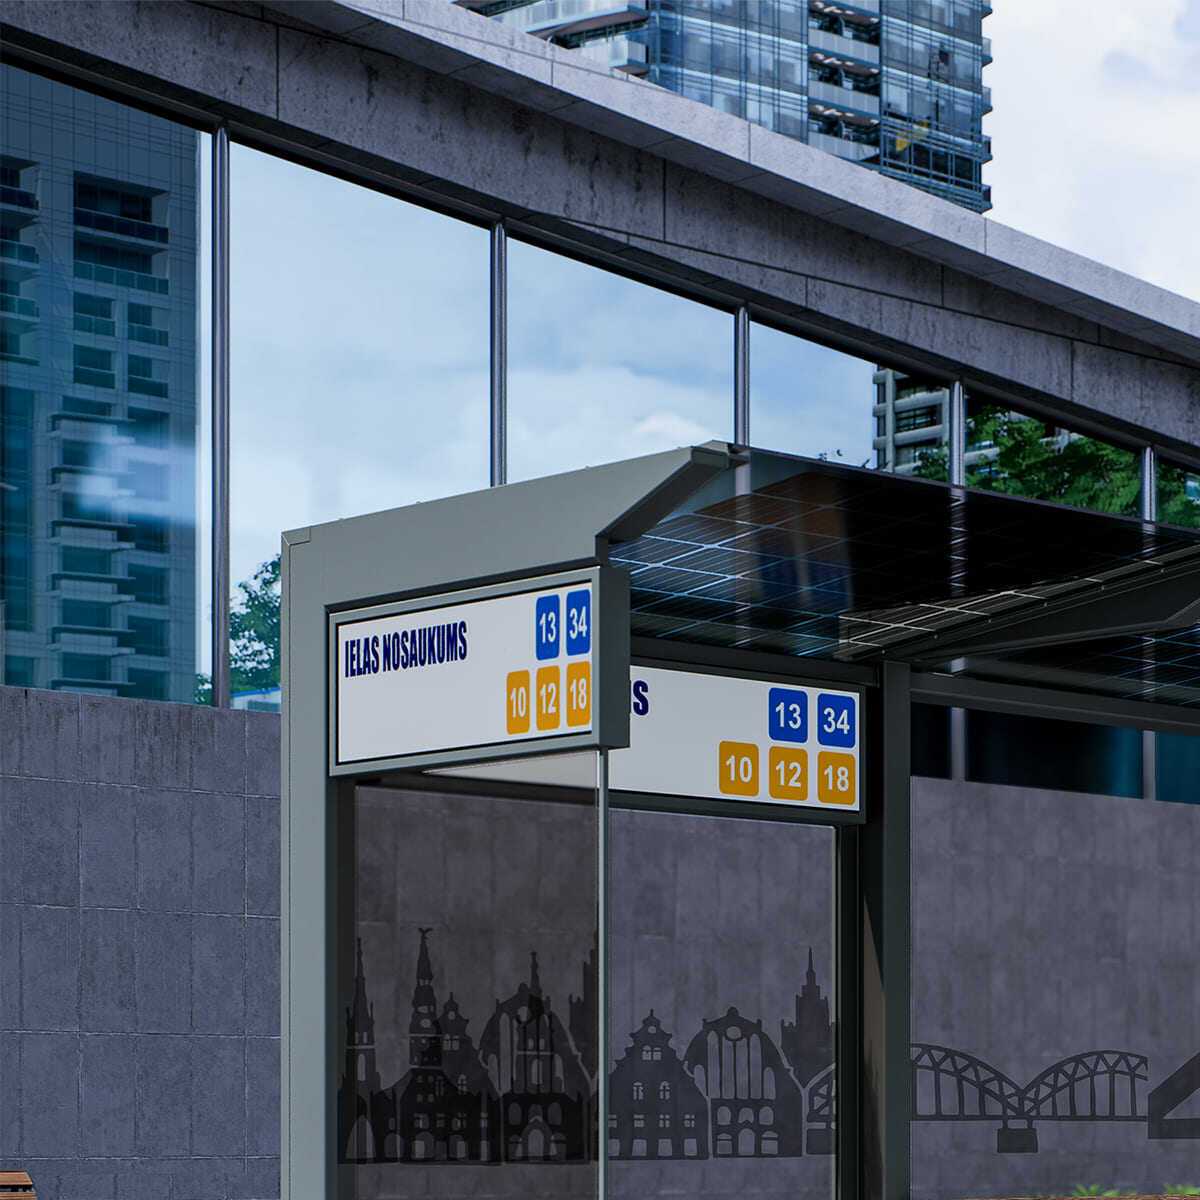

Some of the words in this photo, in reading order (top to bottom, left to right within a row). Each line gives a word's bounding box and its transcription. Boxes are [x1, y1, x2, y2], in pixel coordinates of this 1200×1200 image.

[540, 612, 556, 643] 13
[569, 606, 587, 639] 34
[345, 635, 379, 678] IELAS
[383, 621, 467, 672] NOSAUKUMS
[511, 687, 526, 718] 10
[540, 682, 556, 714] 12
[570, 678, 587, 710] 18
[775, 702, 801, 729] 13
[823, 707, 850, 735] 34
[725, 755, 752, 783] 10
[775, 760, 802, 787] 12
[823, 765, 849, 792] 18
